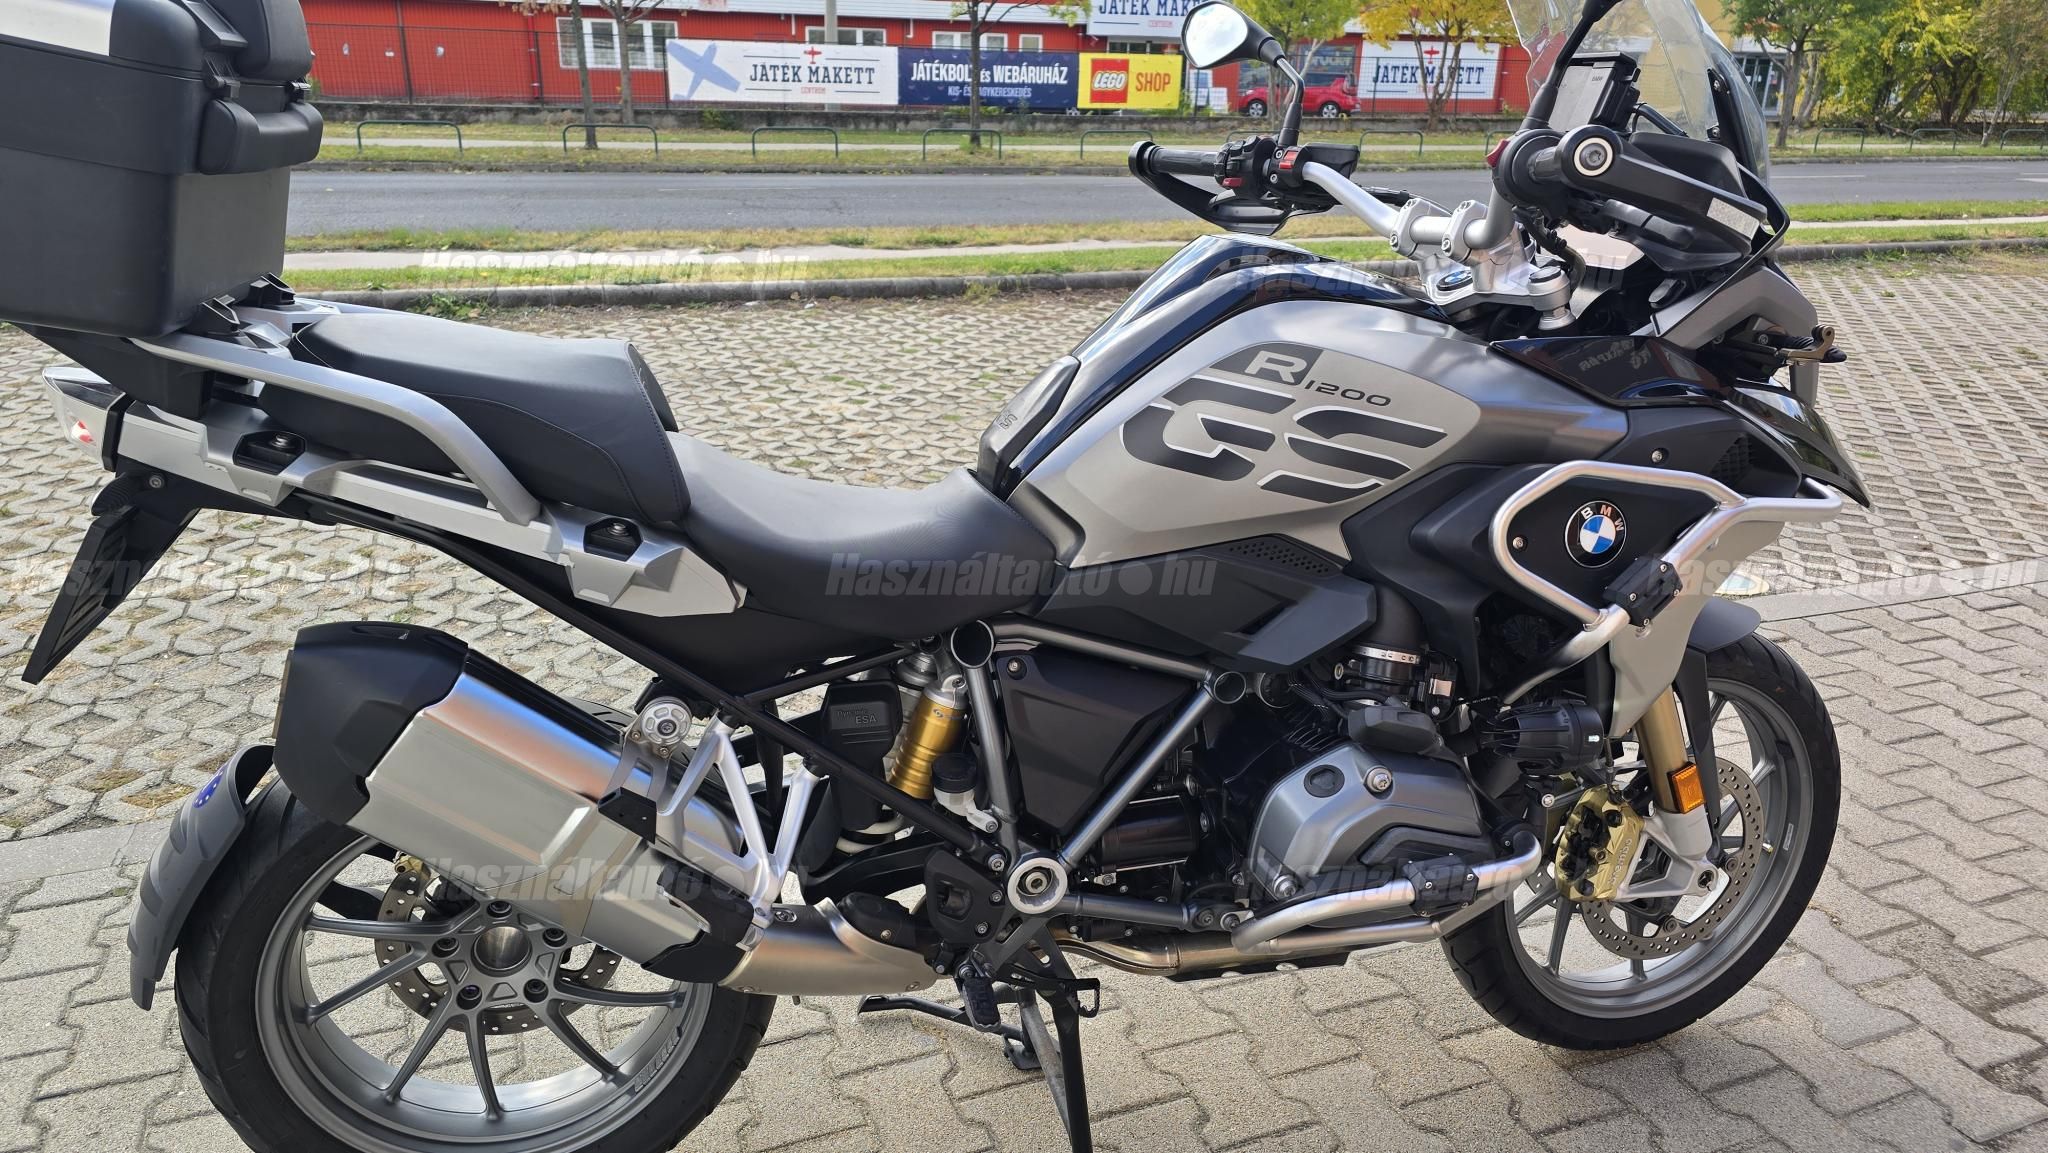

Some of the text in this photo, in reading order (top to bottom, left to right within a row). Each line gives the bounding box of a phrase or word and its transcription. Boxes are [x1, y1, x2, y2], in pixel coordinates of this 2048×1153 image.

[750, 62, 875, 84] JÁTÉK MAKETT
[911, 59, 973, 82] JÁTÉKBOL
[993, 62, 1068, 84] WEBÁRUHÁZ
[1093, 71, 1171, 92] LEGO SHOP
[1424, 66, 1484, 84] METT
[1244, 350, 1391, 407] R 1200
[1120, 374, 1448, 504] GS
[1581, 504, 1624, 531] BMW
[855, 713, 877, 724] ESA
